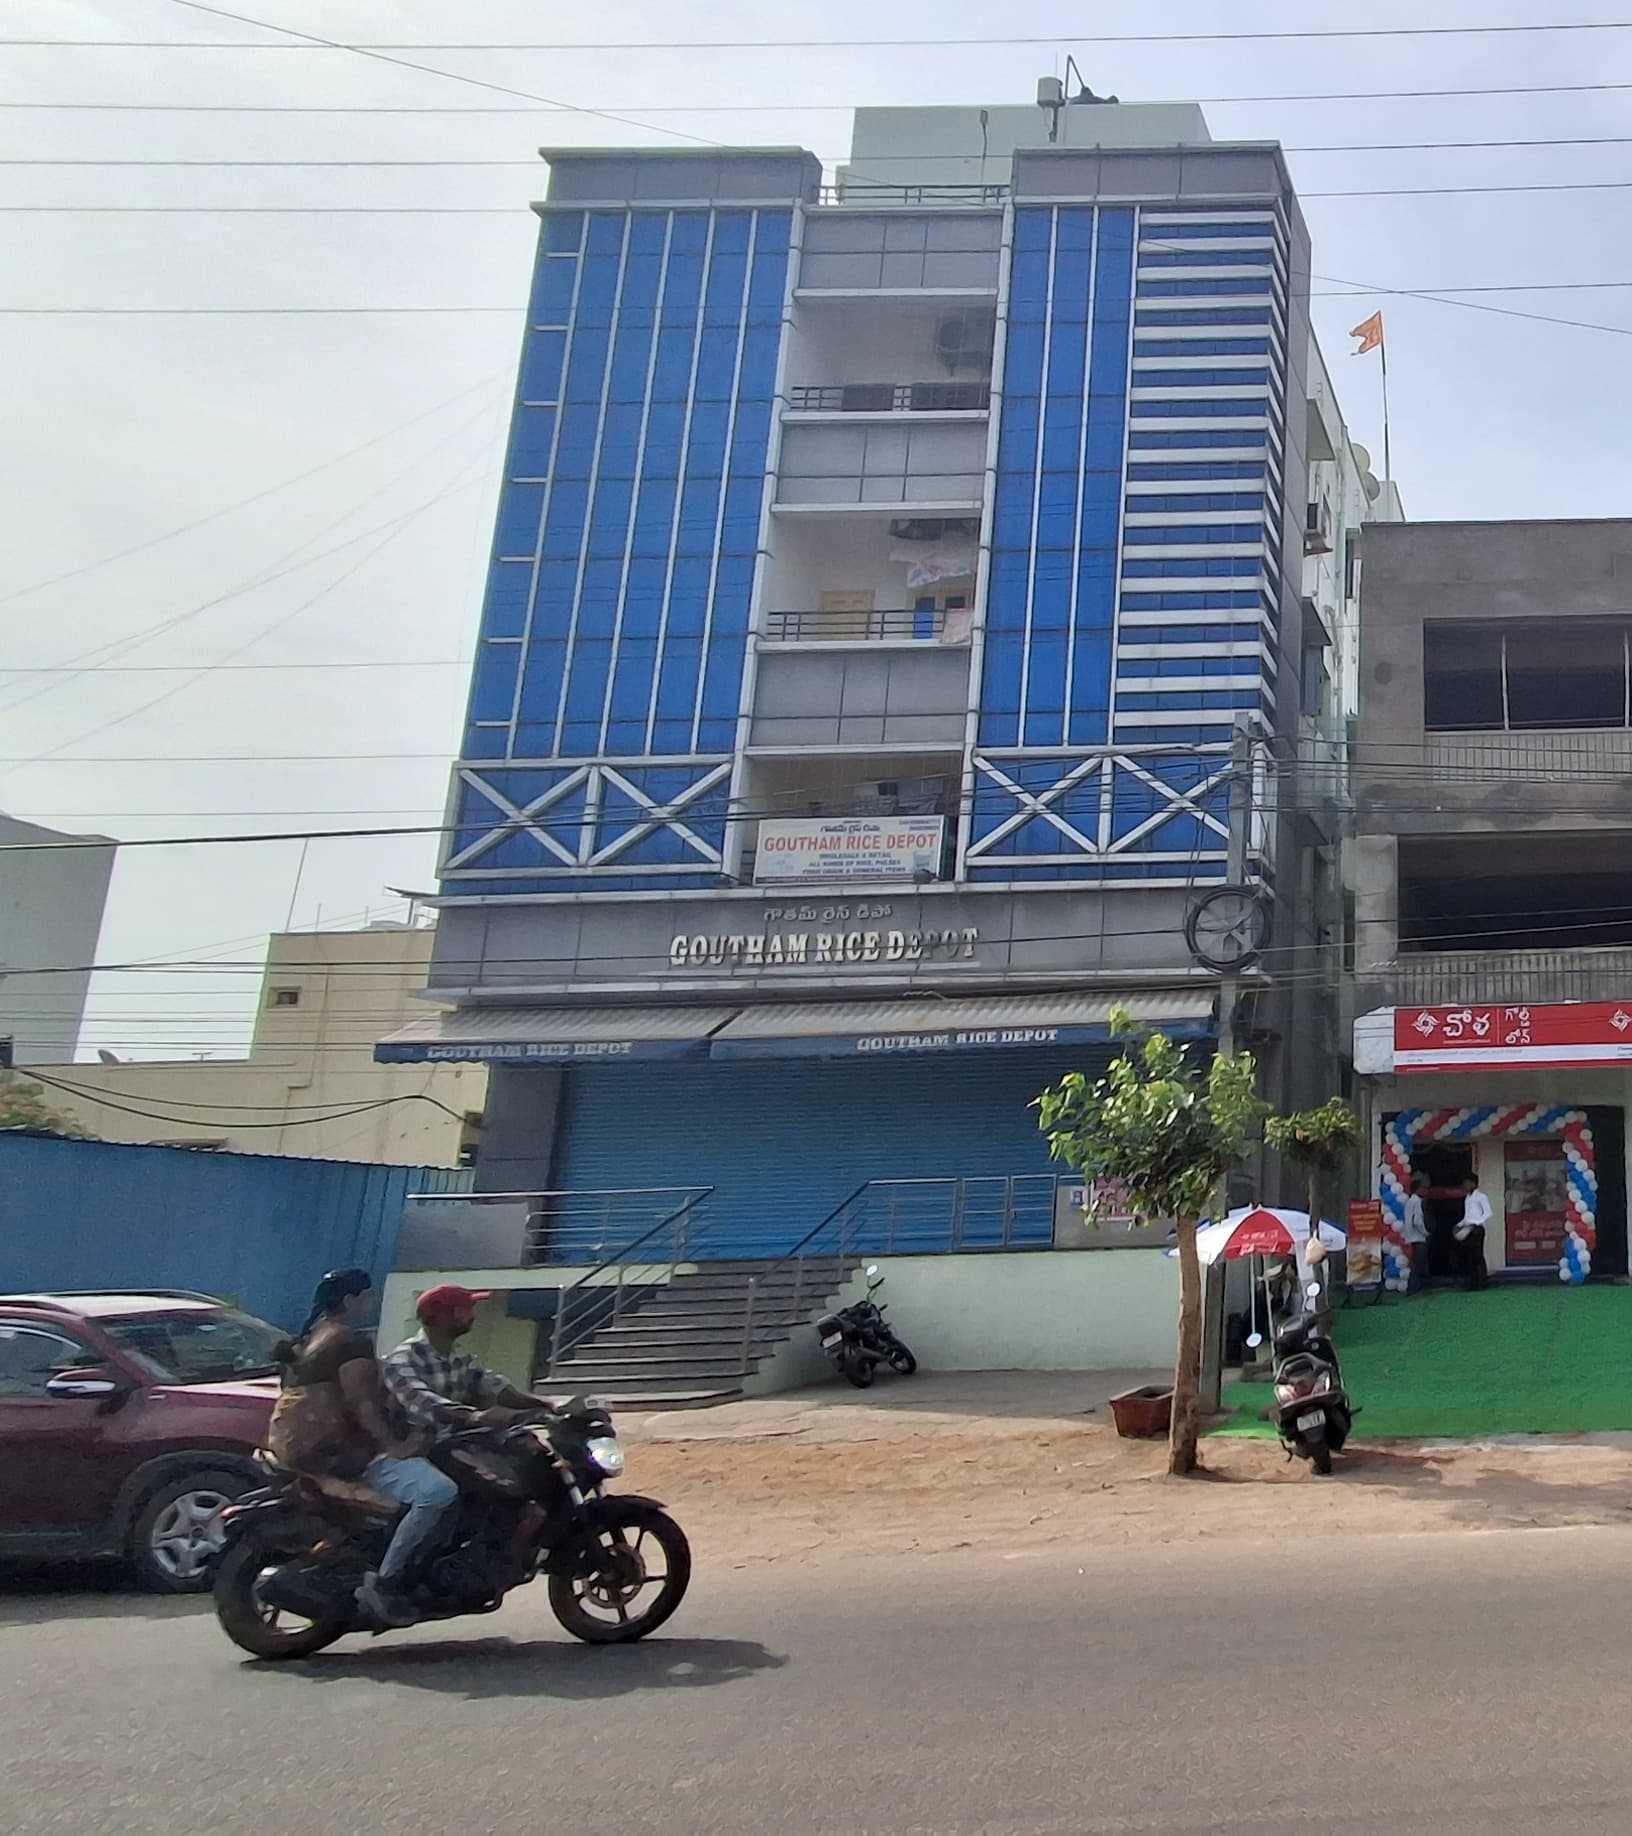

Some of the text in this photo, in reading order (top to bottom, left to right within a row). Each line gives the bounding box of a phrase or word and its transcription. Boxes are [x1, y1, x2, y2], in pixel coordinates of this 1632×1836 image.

[764, 833, 937, 852] GOUTHAM RICE DEPOT
[669, 928, 979, 966] GOUTHAM RICE DEPOT
[857, 1029, 1058, 1050] GOUTHAM RICE DEPOT
[426, 1042, 632, 1059] GOUTHAM RICE DEPOT
